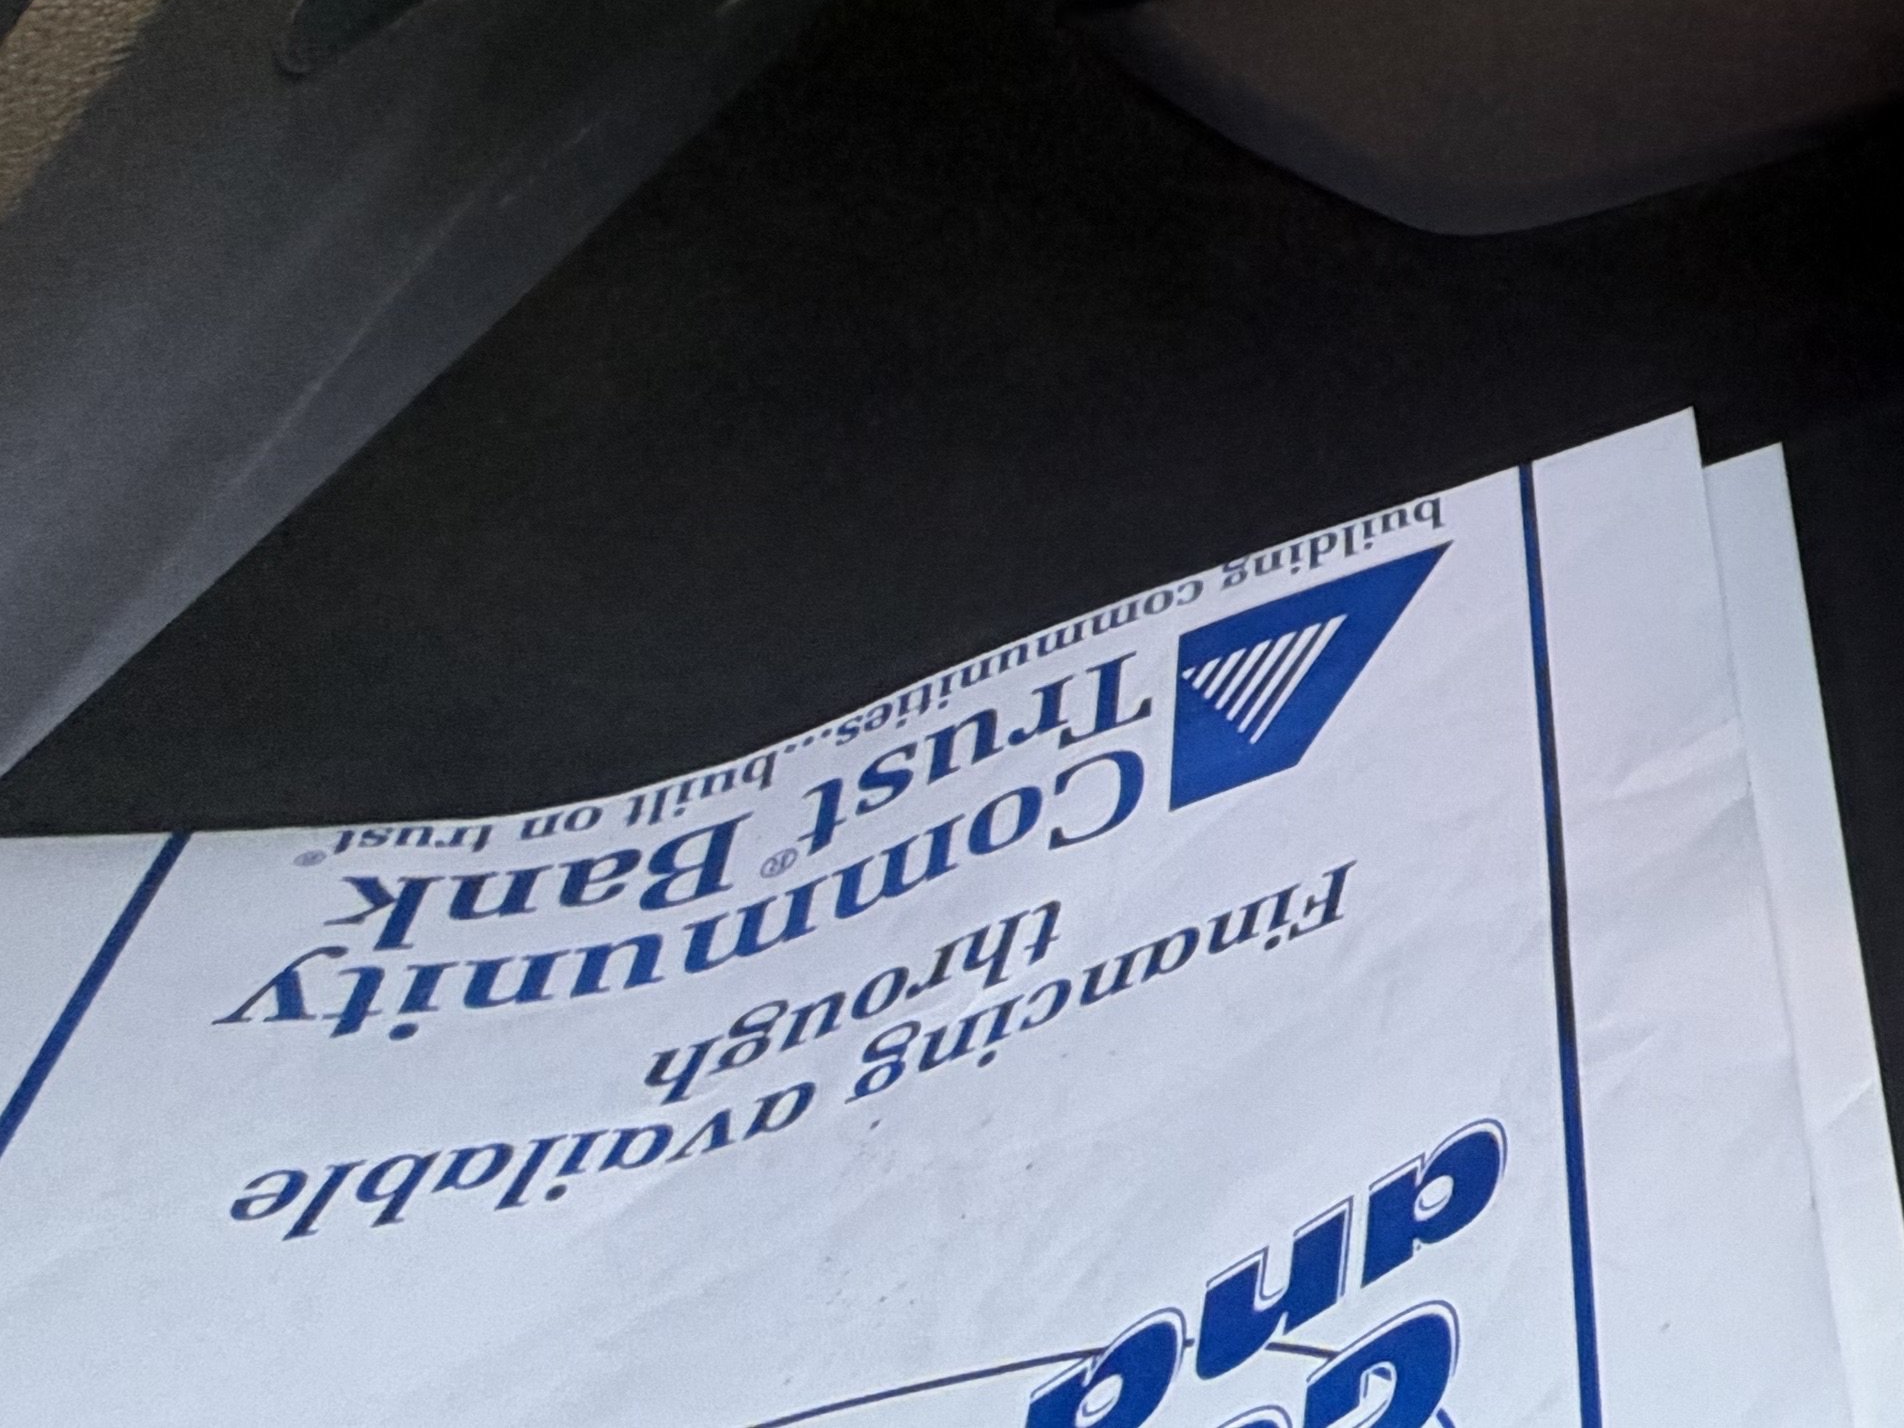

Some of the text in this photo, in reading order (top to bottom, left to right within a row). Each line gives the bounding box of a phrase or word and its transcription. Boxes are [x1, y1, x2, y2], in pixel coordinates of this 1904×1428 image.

[1220, 497, 1441, 591] building
[211, 749, 1144, 1040] Community
[325, 812, 751, 952] Bank
[537, 805, 601, 837] on
[230, 864, 1352, 1242] Financing available
[644, 900, 1060, 1105] through
